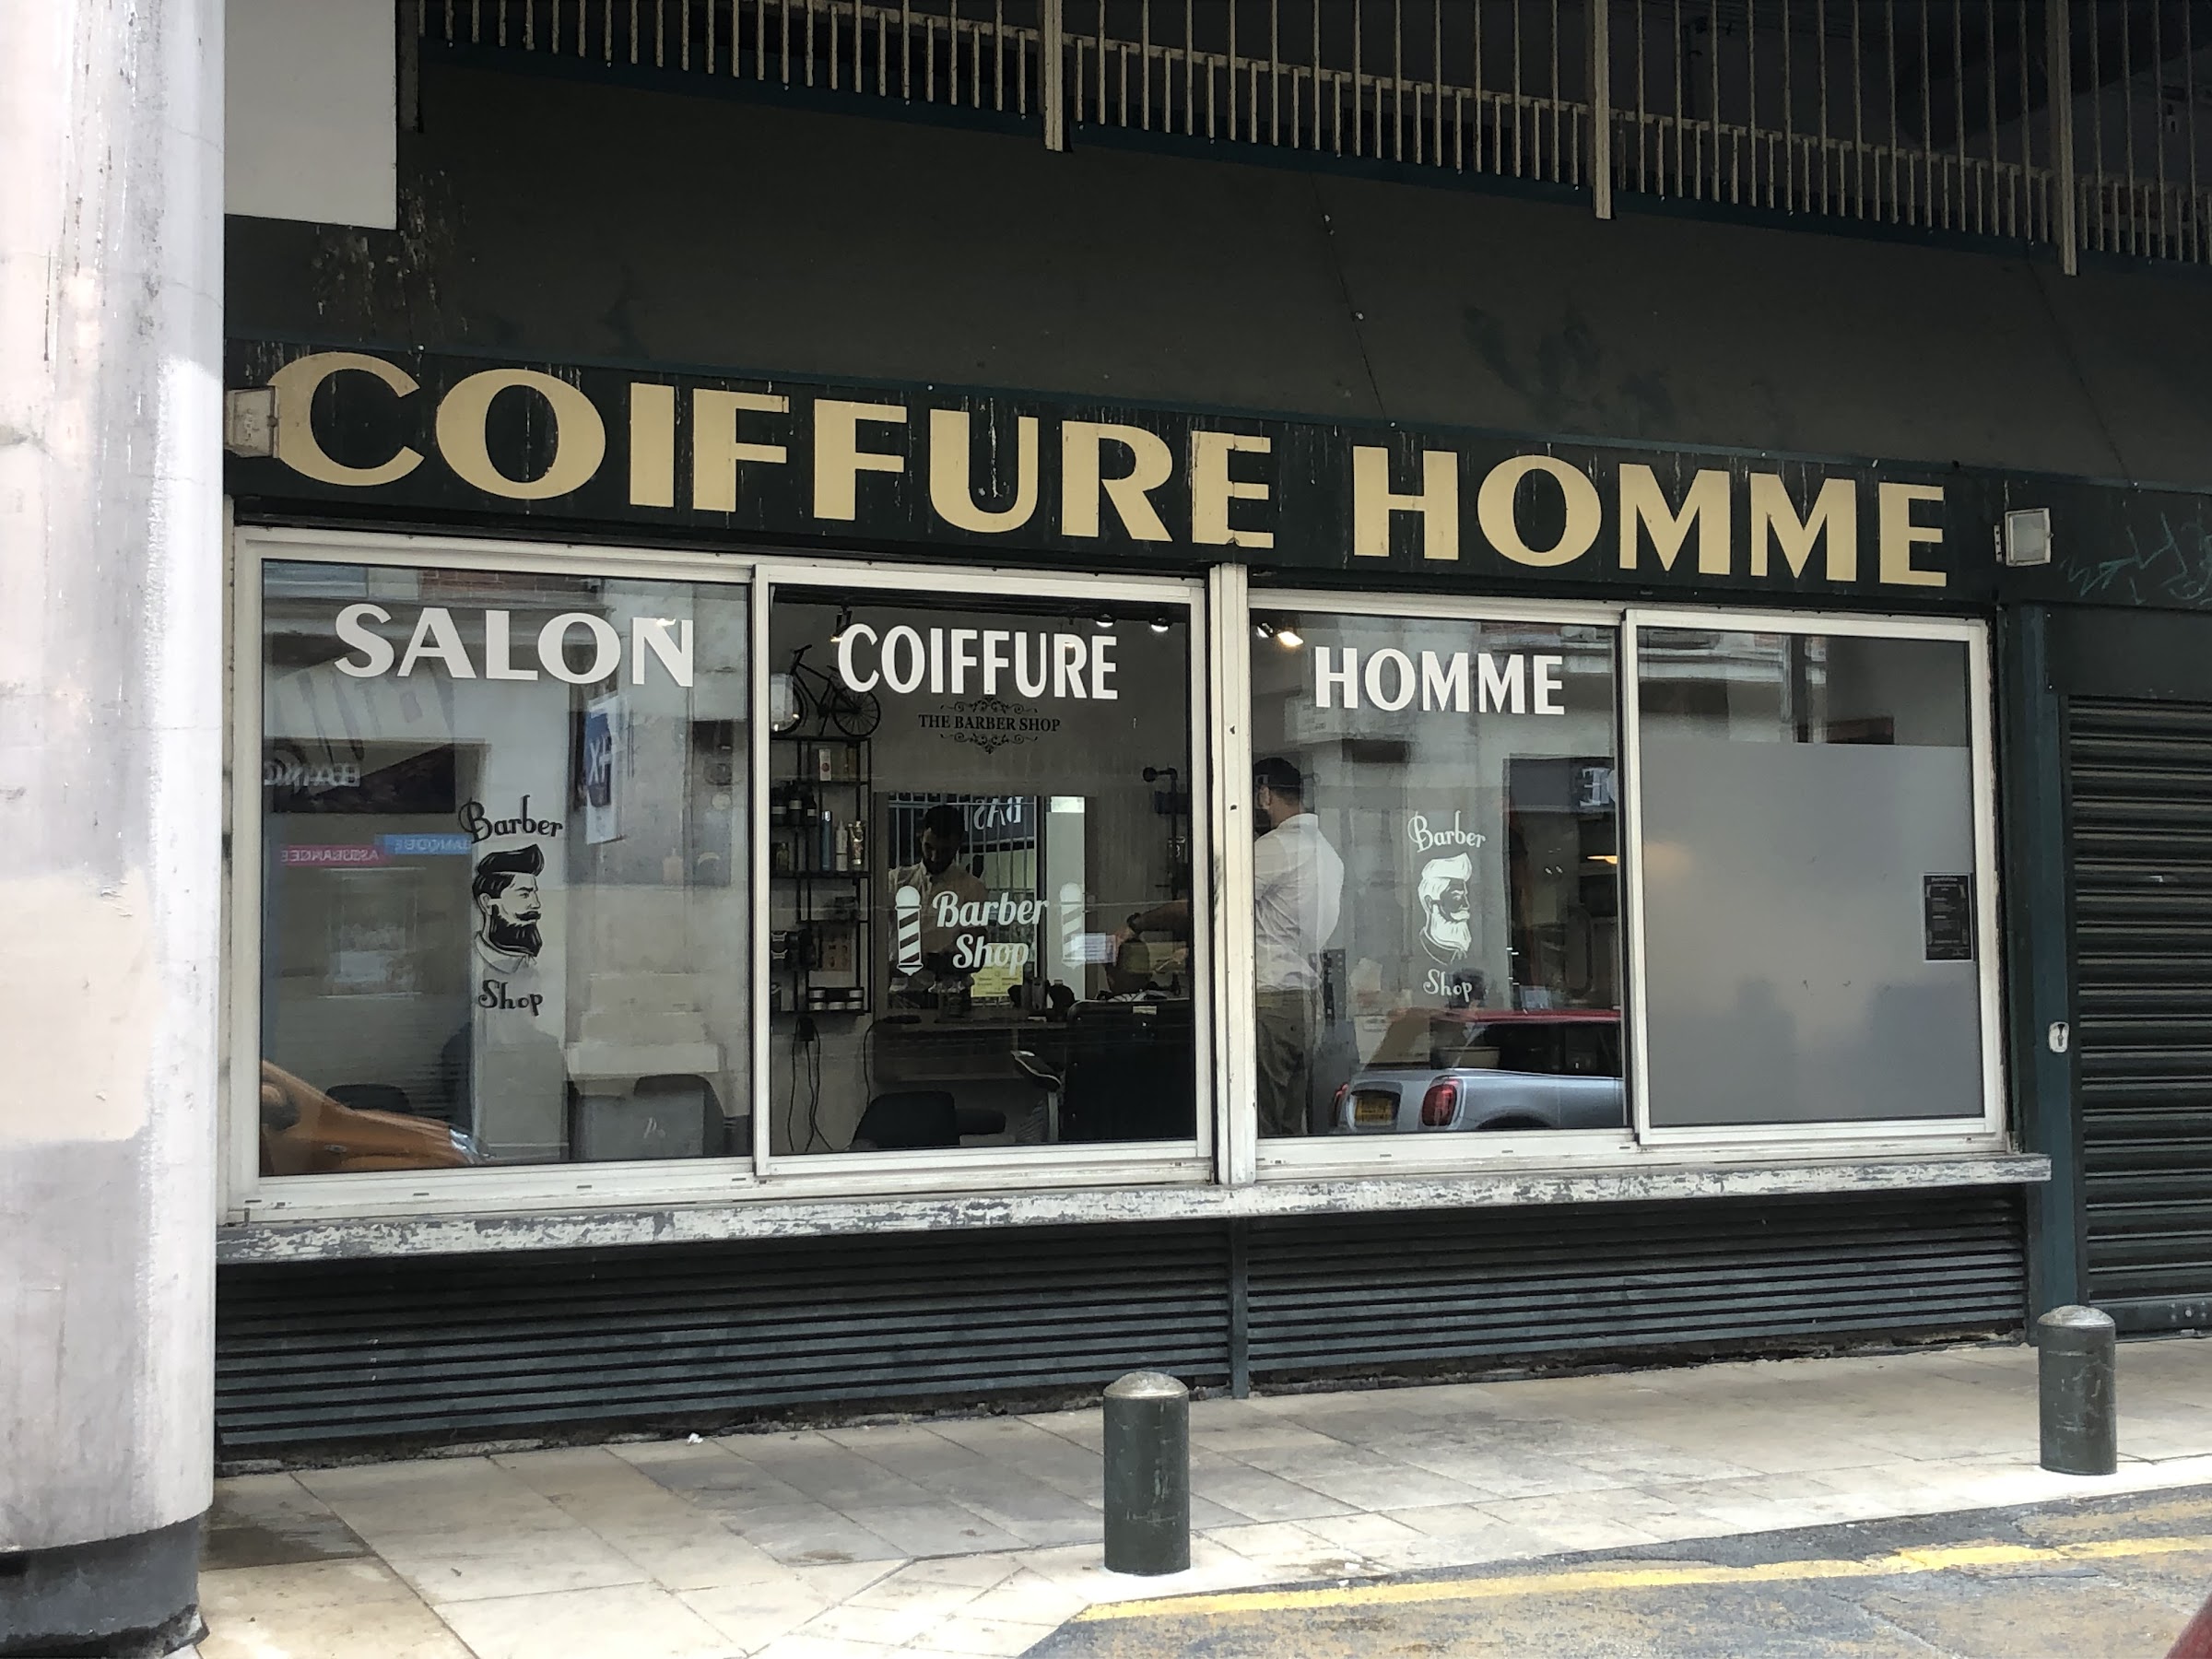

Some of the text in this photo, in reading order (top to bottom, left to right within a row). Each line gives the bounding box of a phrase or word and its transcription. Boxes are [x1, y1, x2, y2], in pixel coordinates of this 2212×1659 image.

[268, 351, 1274, 548] COIFFURE
[1352, 444, 1947, 587] HOMME
[334, 603, 1566, 716] SALON COIFFURE HOMME
[918, 714, 1060, 732] THE BARBER SHOP
[458, 795, 563, 844] Barber
[1407, 810, 1486, 853] Barber
[932, 890, 1050, 928] Barber
[952, 933, 1030, 976] Shop
[477, 980, 544, 1017] Shop
[1423, 969, 1473, 1003] Shop
